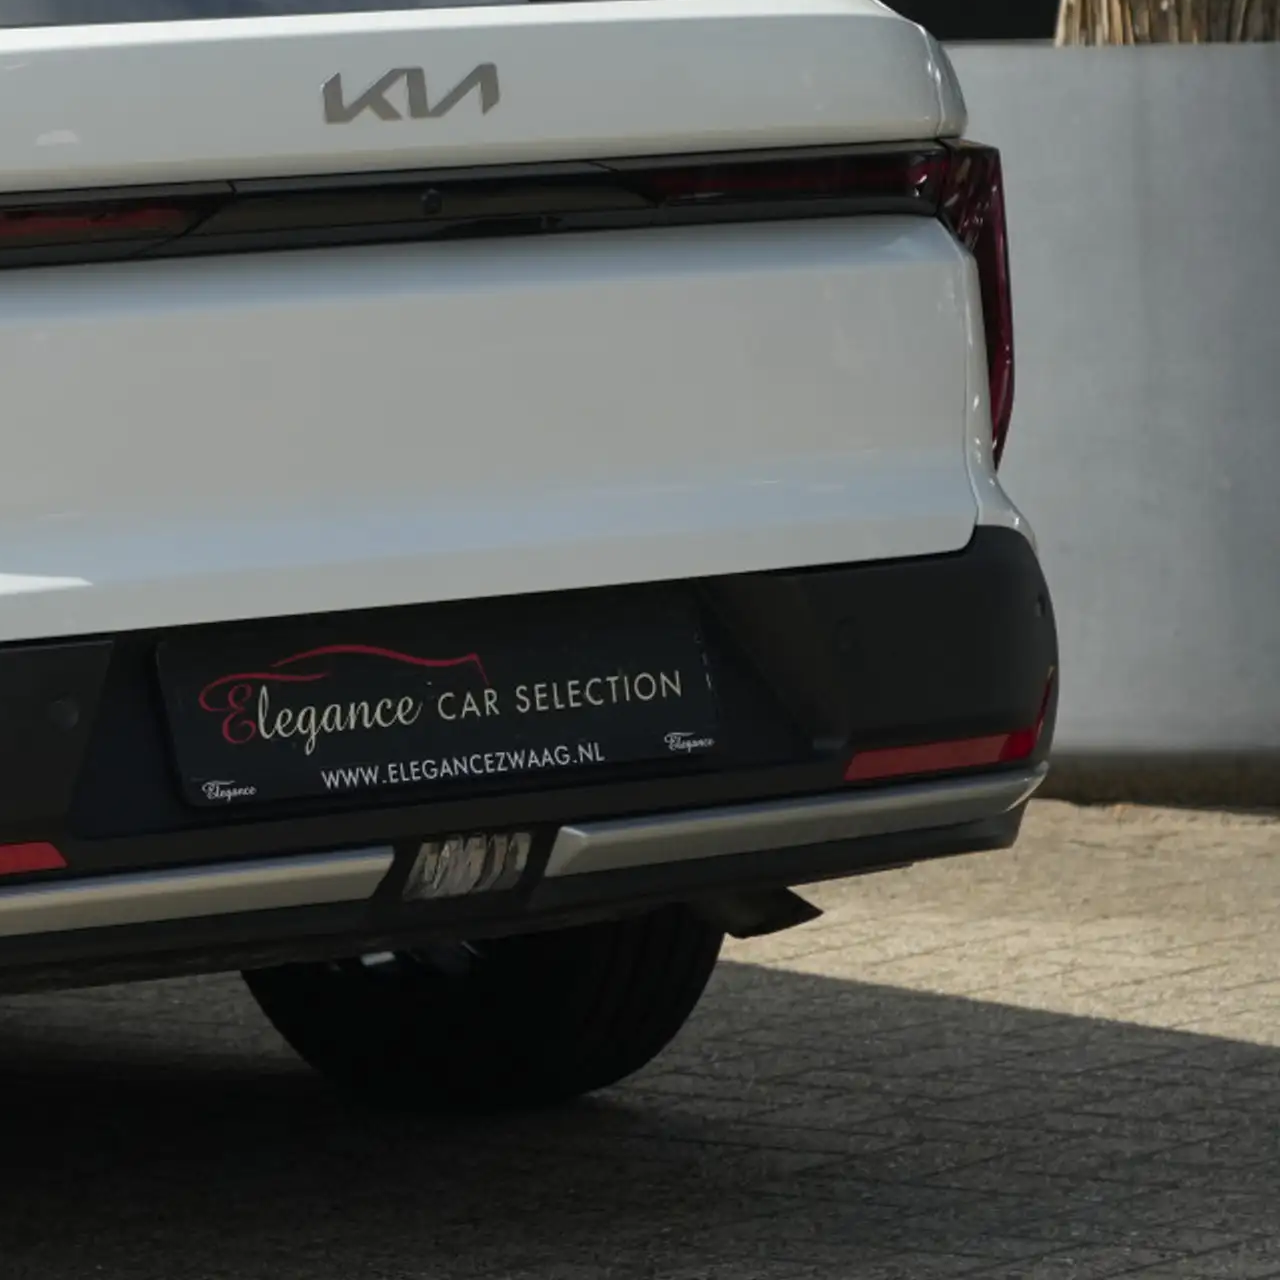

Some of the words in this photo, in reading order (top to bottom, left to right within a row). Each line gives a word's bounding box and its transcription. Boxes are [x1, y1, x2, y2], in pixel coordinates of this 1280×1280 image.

[320, 62, 501, 124] KIA
[198, 673, 422, 756] Elegance
[436, 687, 500, 722] CAR
[514, 669, 683, 714] SELECTION
[201, 780, 258, 804] Elegance
[321, 742, 606, 790] WWW.ELEGANCEZWAAG.NL
